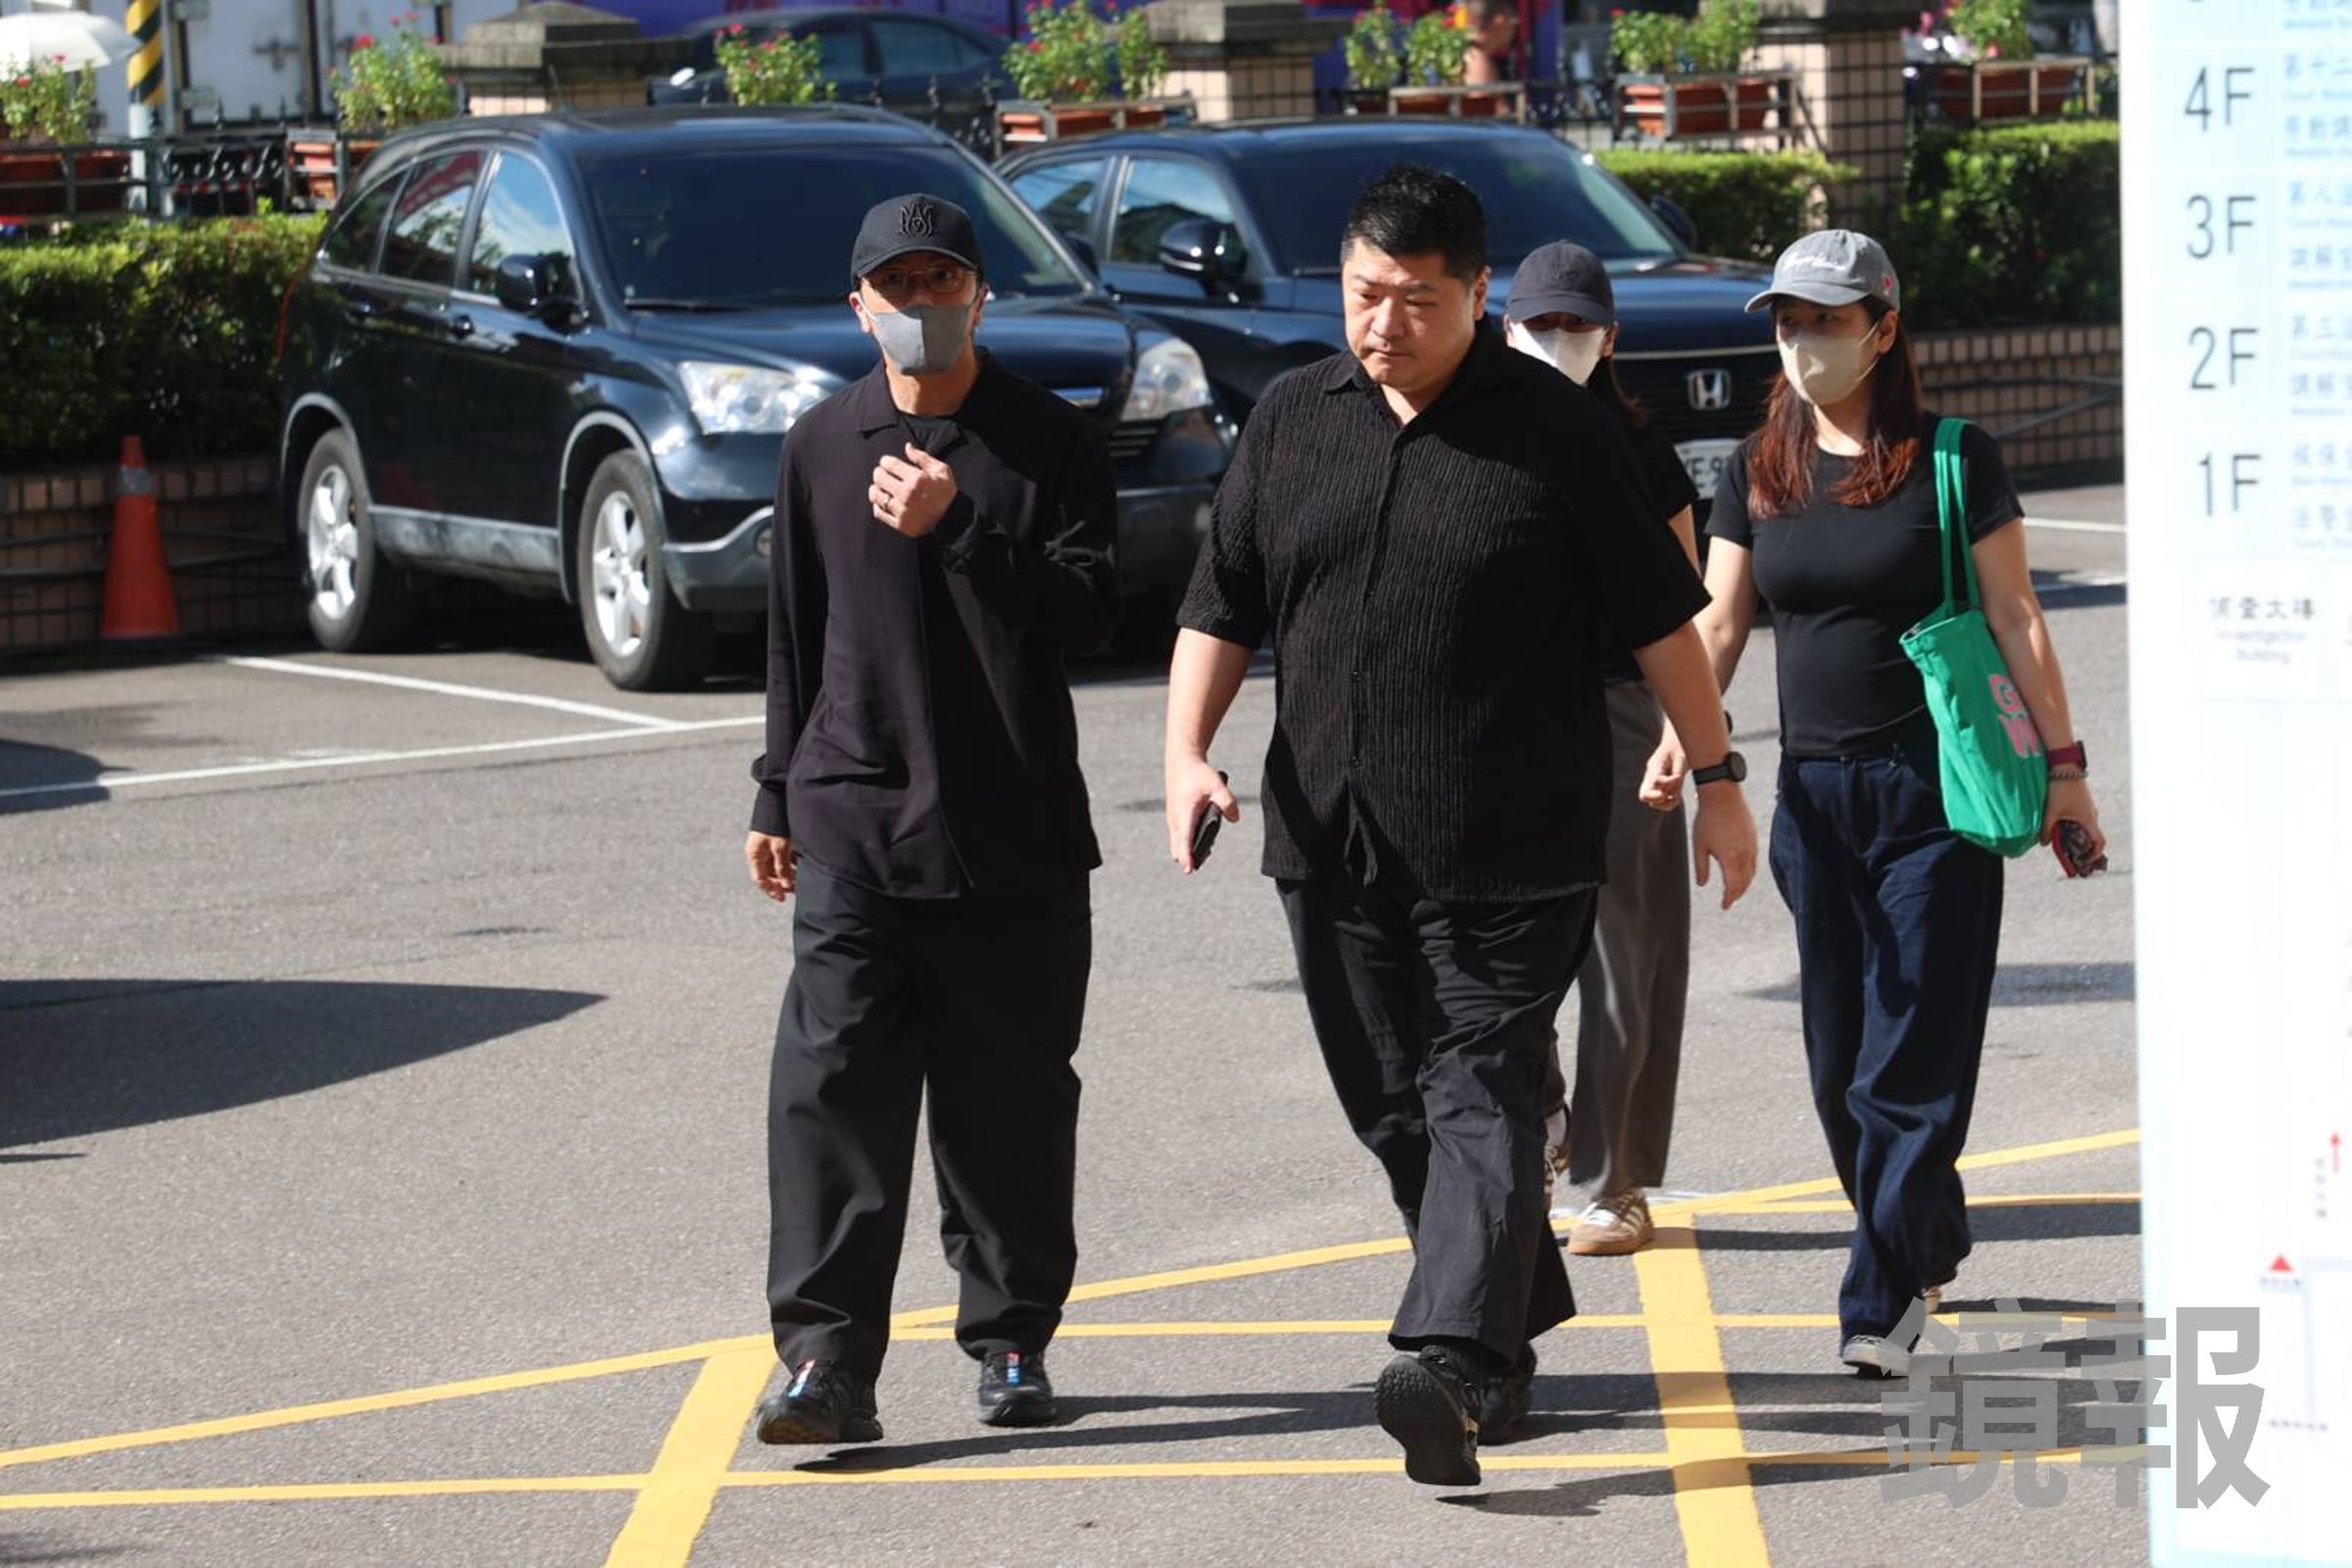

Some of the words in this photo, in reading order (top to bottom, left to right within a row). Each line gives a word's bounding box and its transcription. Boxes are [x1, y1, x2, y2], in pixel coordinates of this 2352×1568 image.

[2184, 66, 2255, 130] 4F
[2185, 194, 2256, 260] 3F
[2188, 325, 2258, 390] 2F
[2198, 451, 2262, 516] 1F
